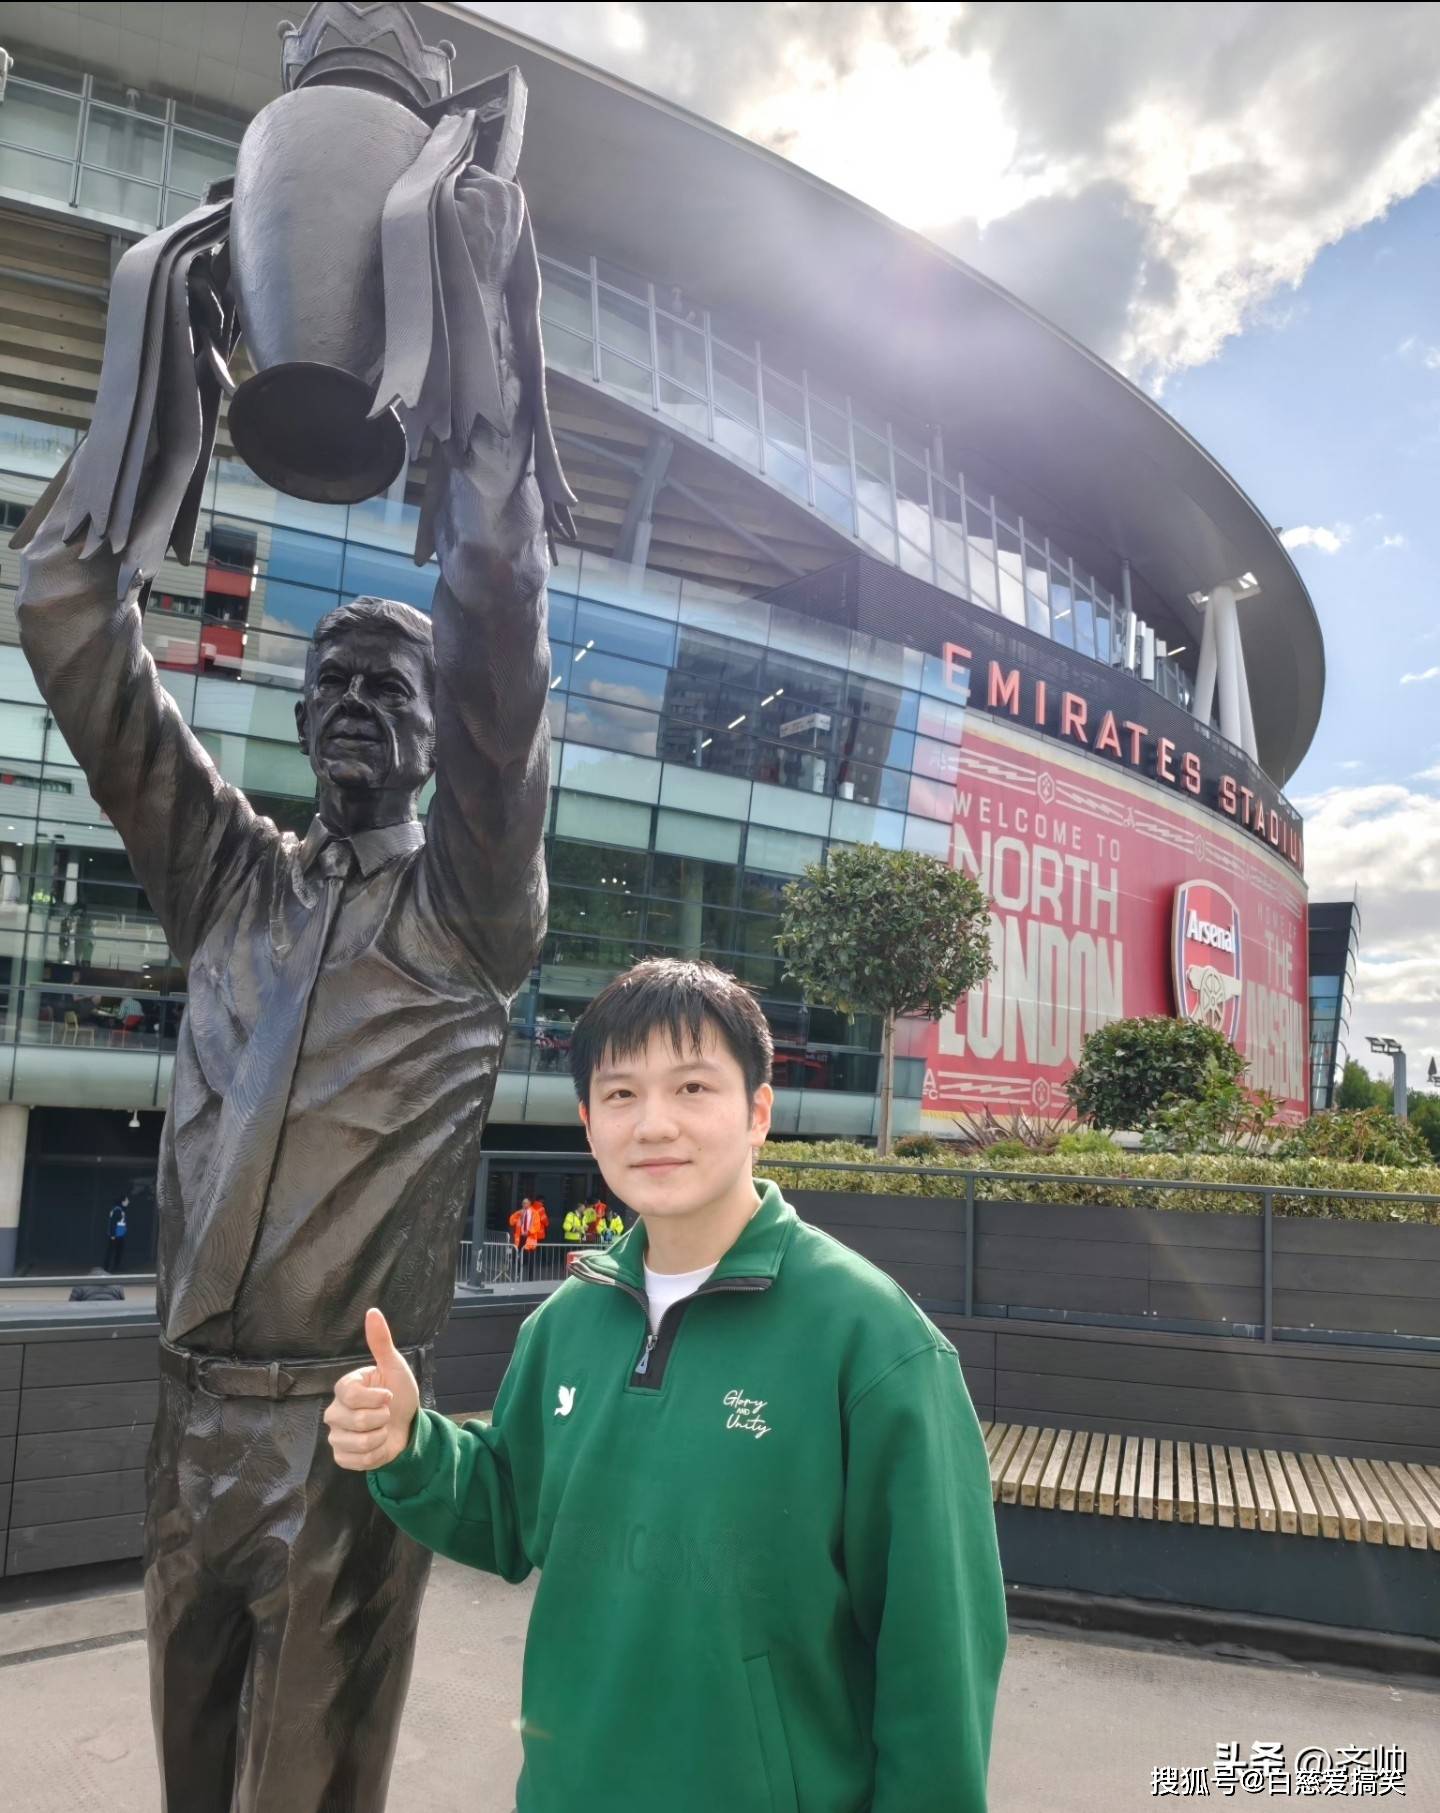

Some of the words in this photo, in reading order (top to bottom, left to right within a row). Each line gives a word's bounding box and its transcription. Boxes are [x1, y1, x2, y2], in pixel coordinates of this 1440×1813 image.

[943, 642, 1201, 795] EMIRATES
[1220, 775, 1303, 872] STADIU
[952, 788, 1082, 851] WELCOME
[1097, 833, 1120, 863] TO
[953, 822, 1119, 935] NORTH
[1186, 908, 1236, 954] Arsenal
[1264, 929, 1293, 995] THE
[1244, 979, 1304, 1102] ARSE
[723, 1389, 768, 1414] Glory
[726, 1413, 772, 1439] Unity
